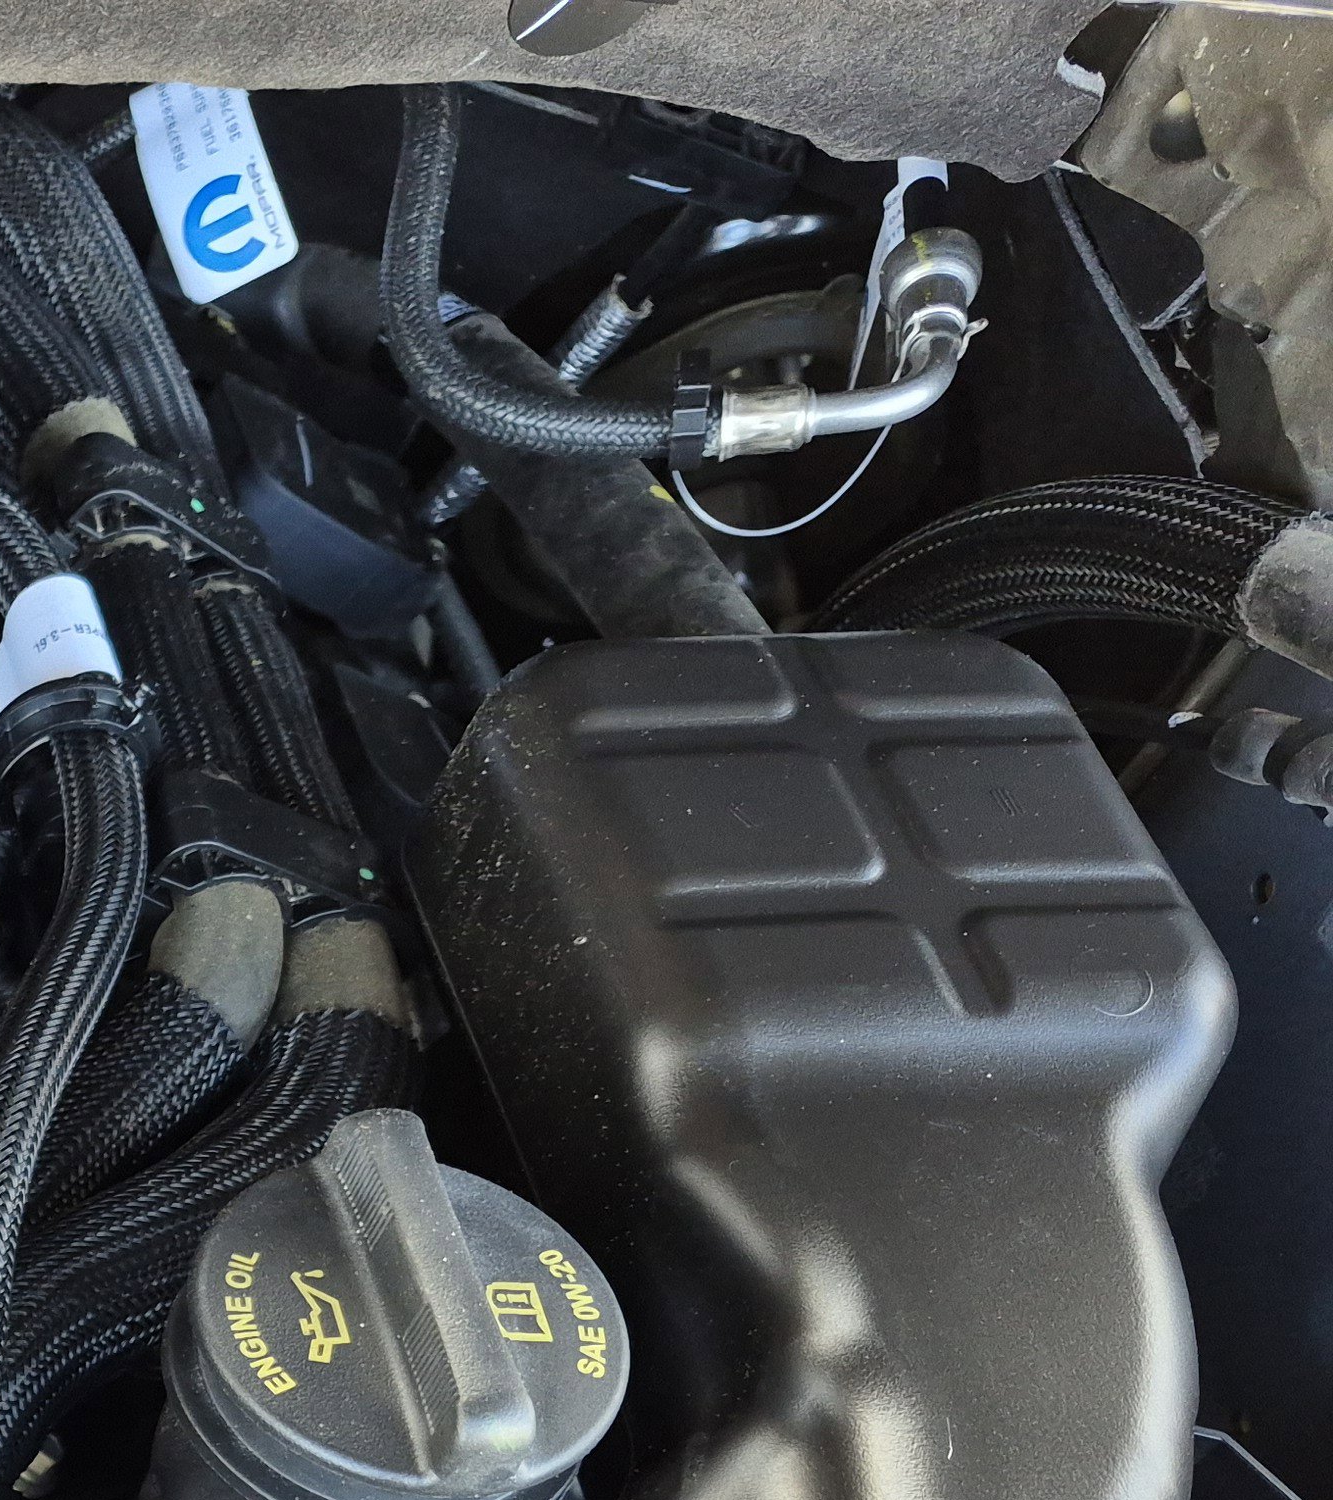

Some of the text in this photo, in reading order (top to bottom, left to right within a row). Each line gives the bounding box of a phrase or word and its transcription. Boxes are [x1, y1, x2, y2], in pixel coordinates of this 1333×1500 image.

[224, 1251, 298, 1396] ENGINE OIL
[538, 1249, 607, 1379] SAE 0W-20
